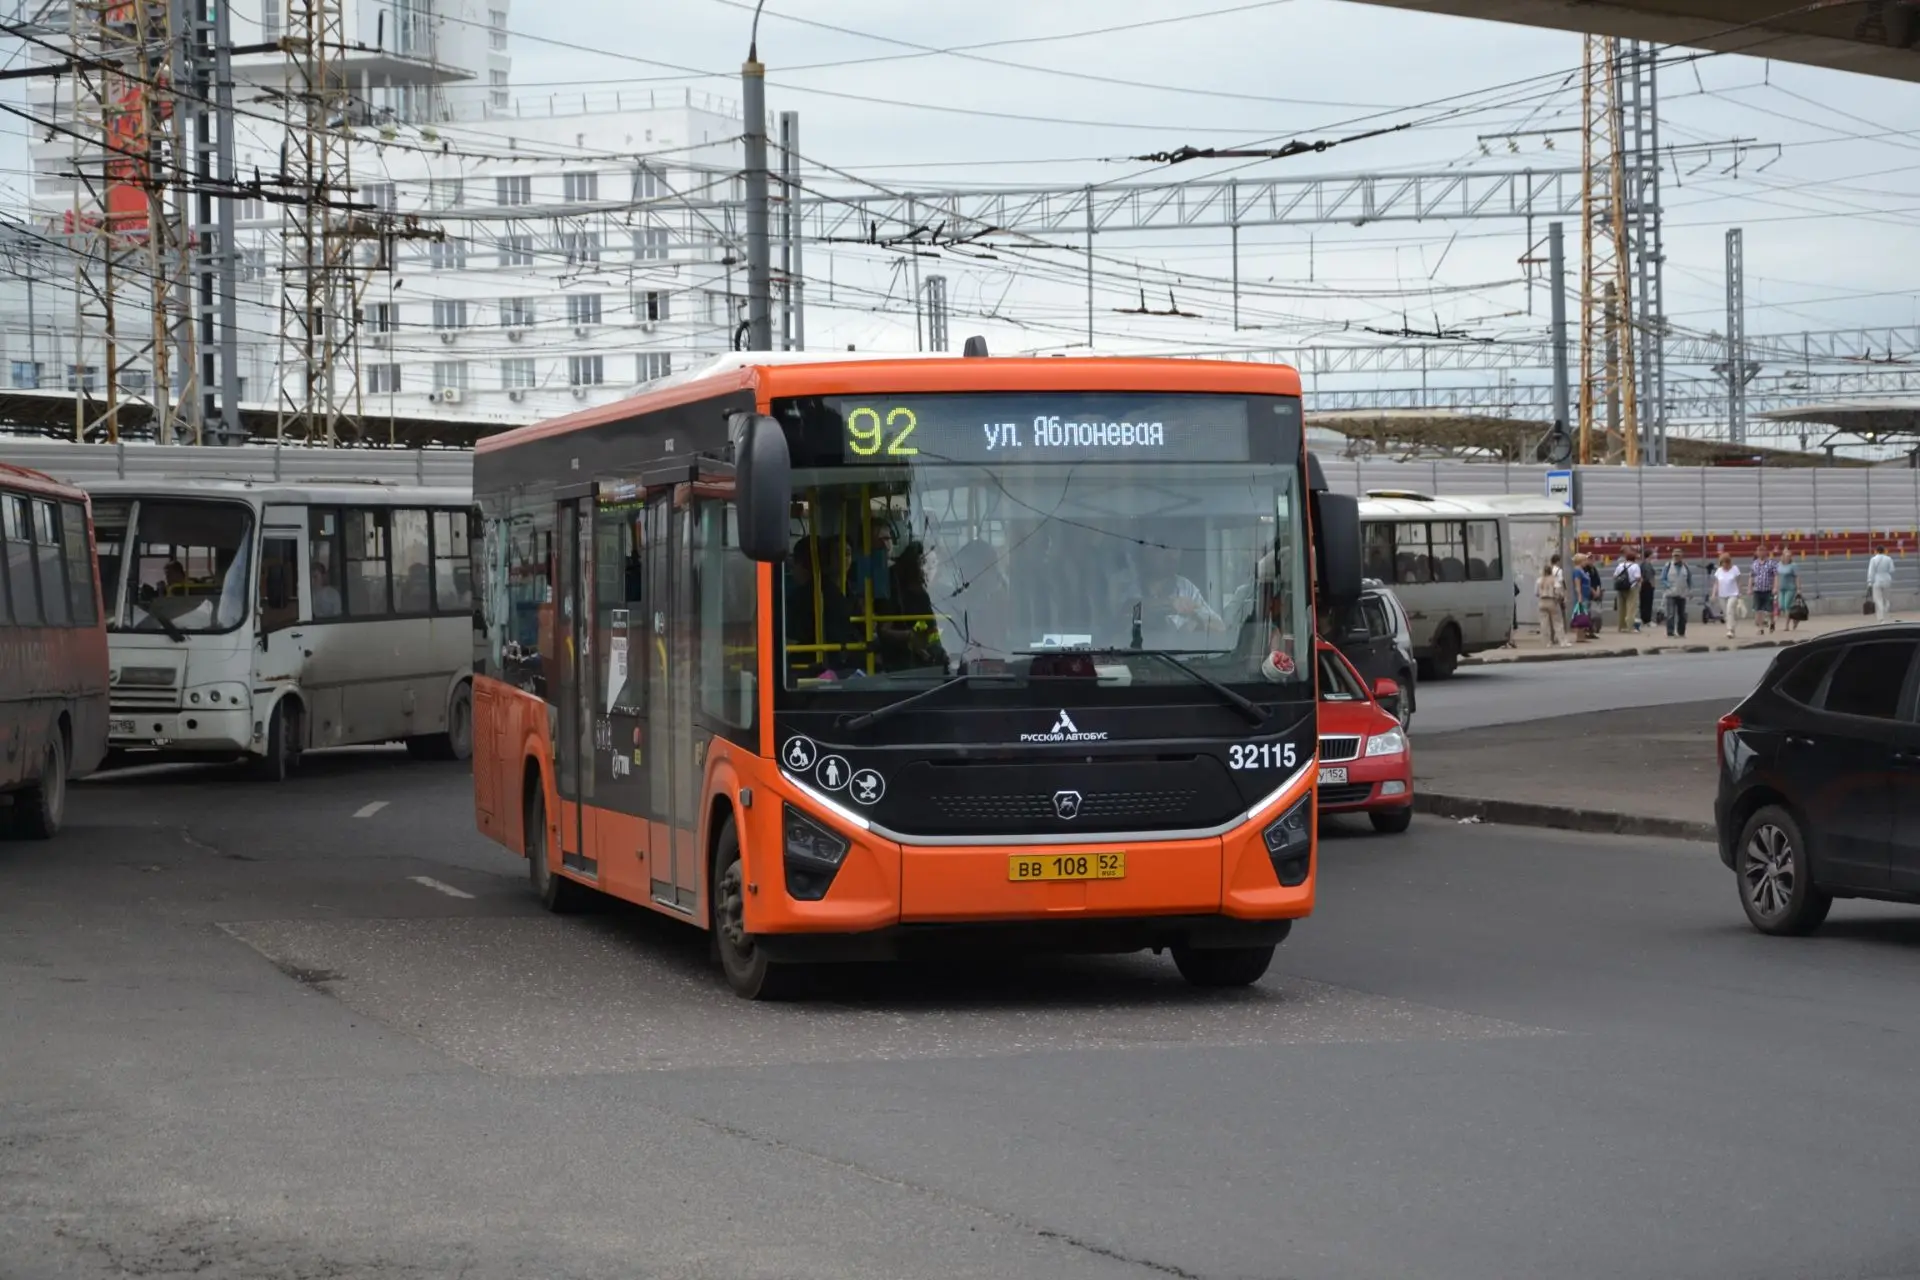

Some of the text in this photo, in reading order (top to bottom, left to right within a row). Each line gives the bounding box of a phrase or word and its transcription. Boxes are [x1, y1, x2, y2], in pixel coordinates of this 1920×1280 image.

[848, 407, 918, 455] 92
[984, 416, 1164, 450] ул. Яблоневая
[1020, 731, 1108, 742] РУССКИЙ АВТОБУС
[1229, 743, 1297, 770] 32115
[1328, 769, 1344, 778] 152
[1019, 855, 1118, 877] ВВ 108 52
